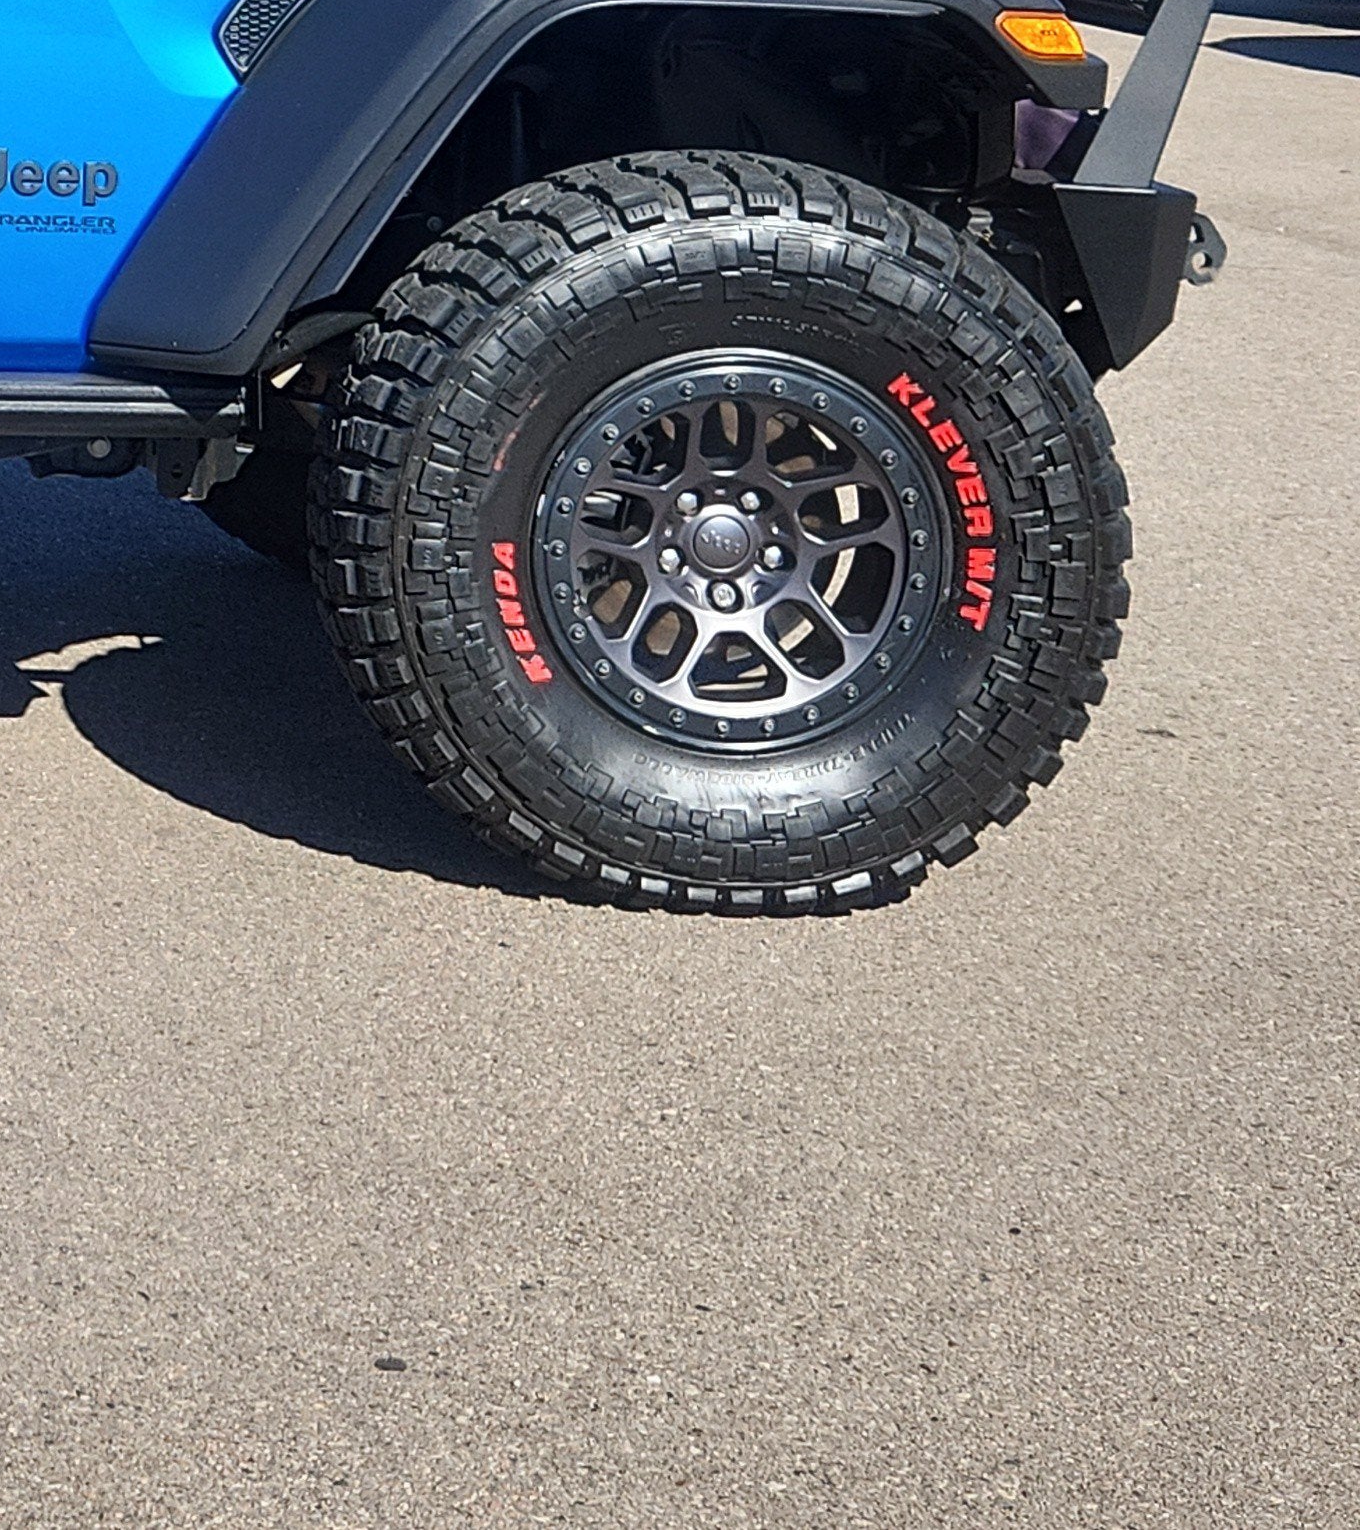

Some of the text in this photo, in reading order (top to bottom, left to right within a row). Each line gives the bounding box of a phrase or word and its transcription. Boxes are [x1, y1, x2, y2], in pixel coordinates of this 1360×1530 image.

[15, 225, 118, 236] UNLIMITED
[886, 371, 997, 632] KLEVER M/T
[491, 542, 553, 684] KENDA
